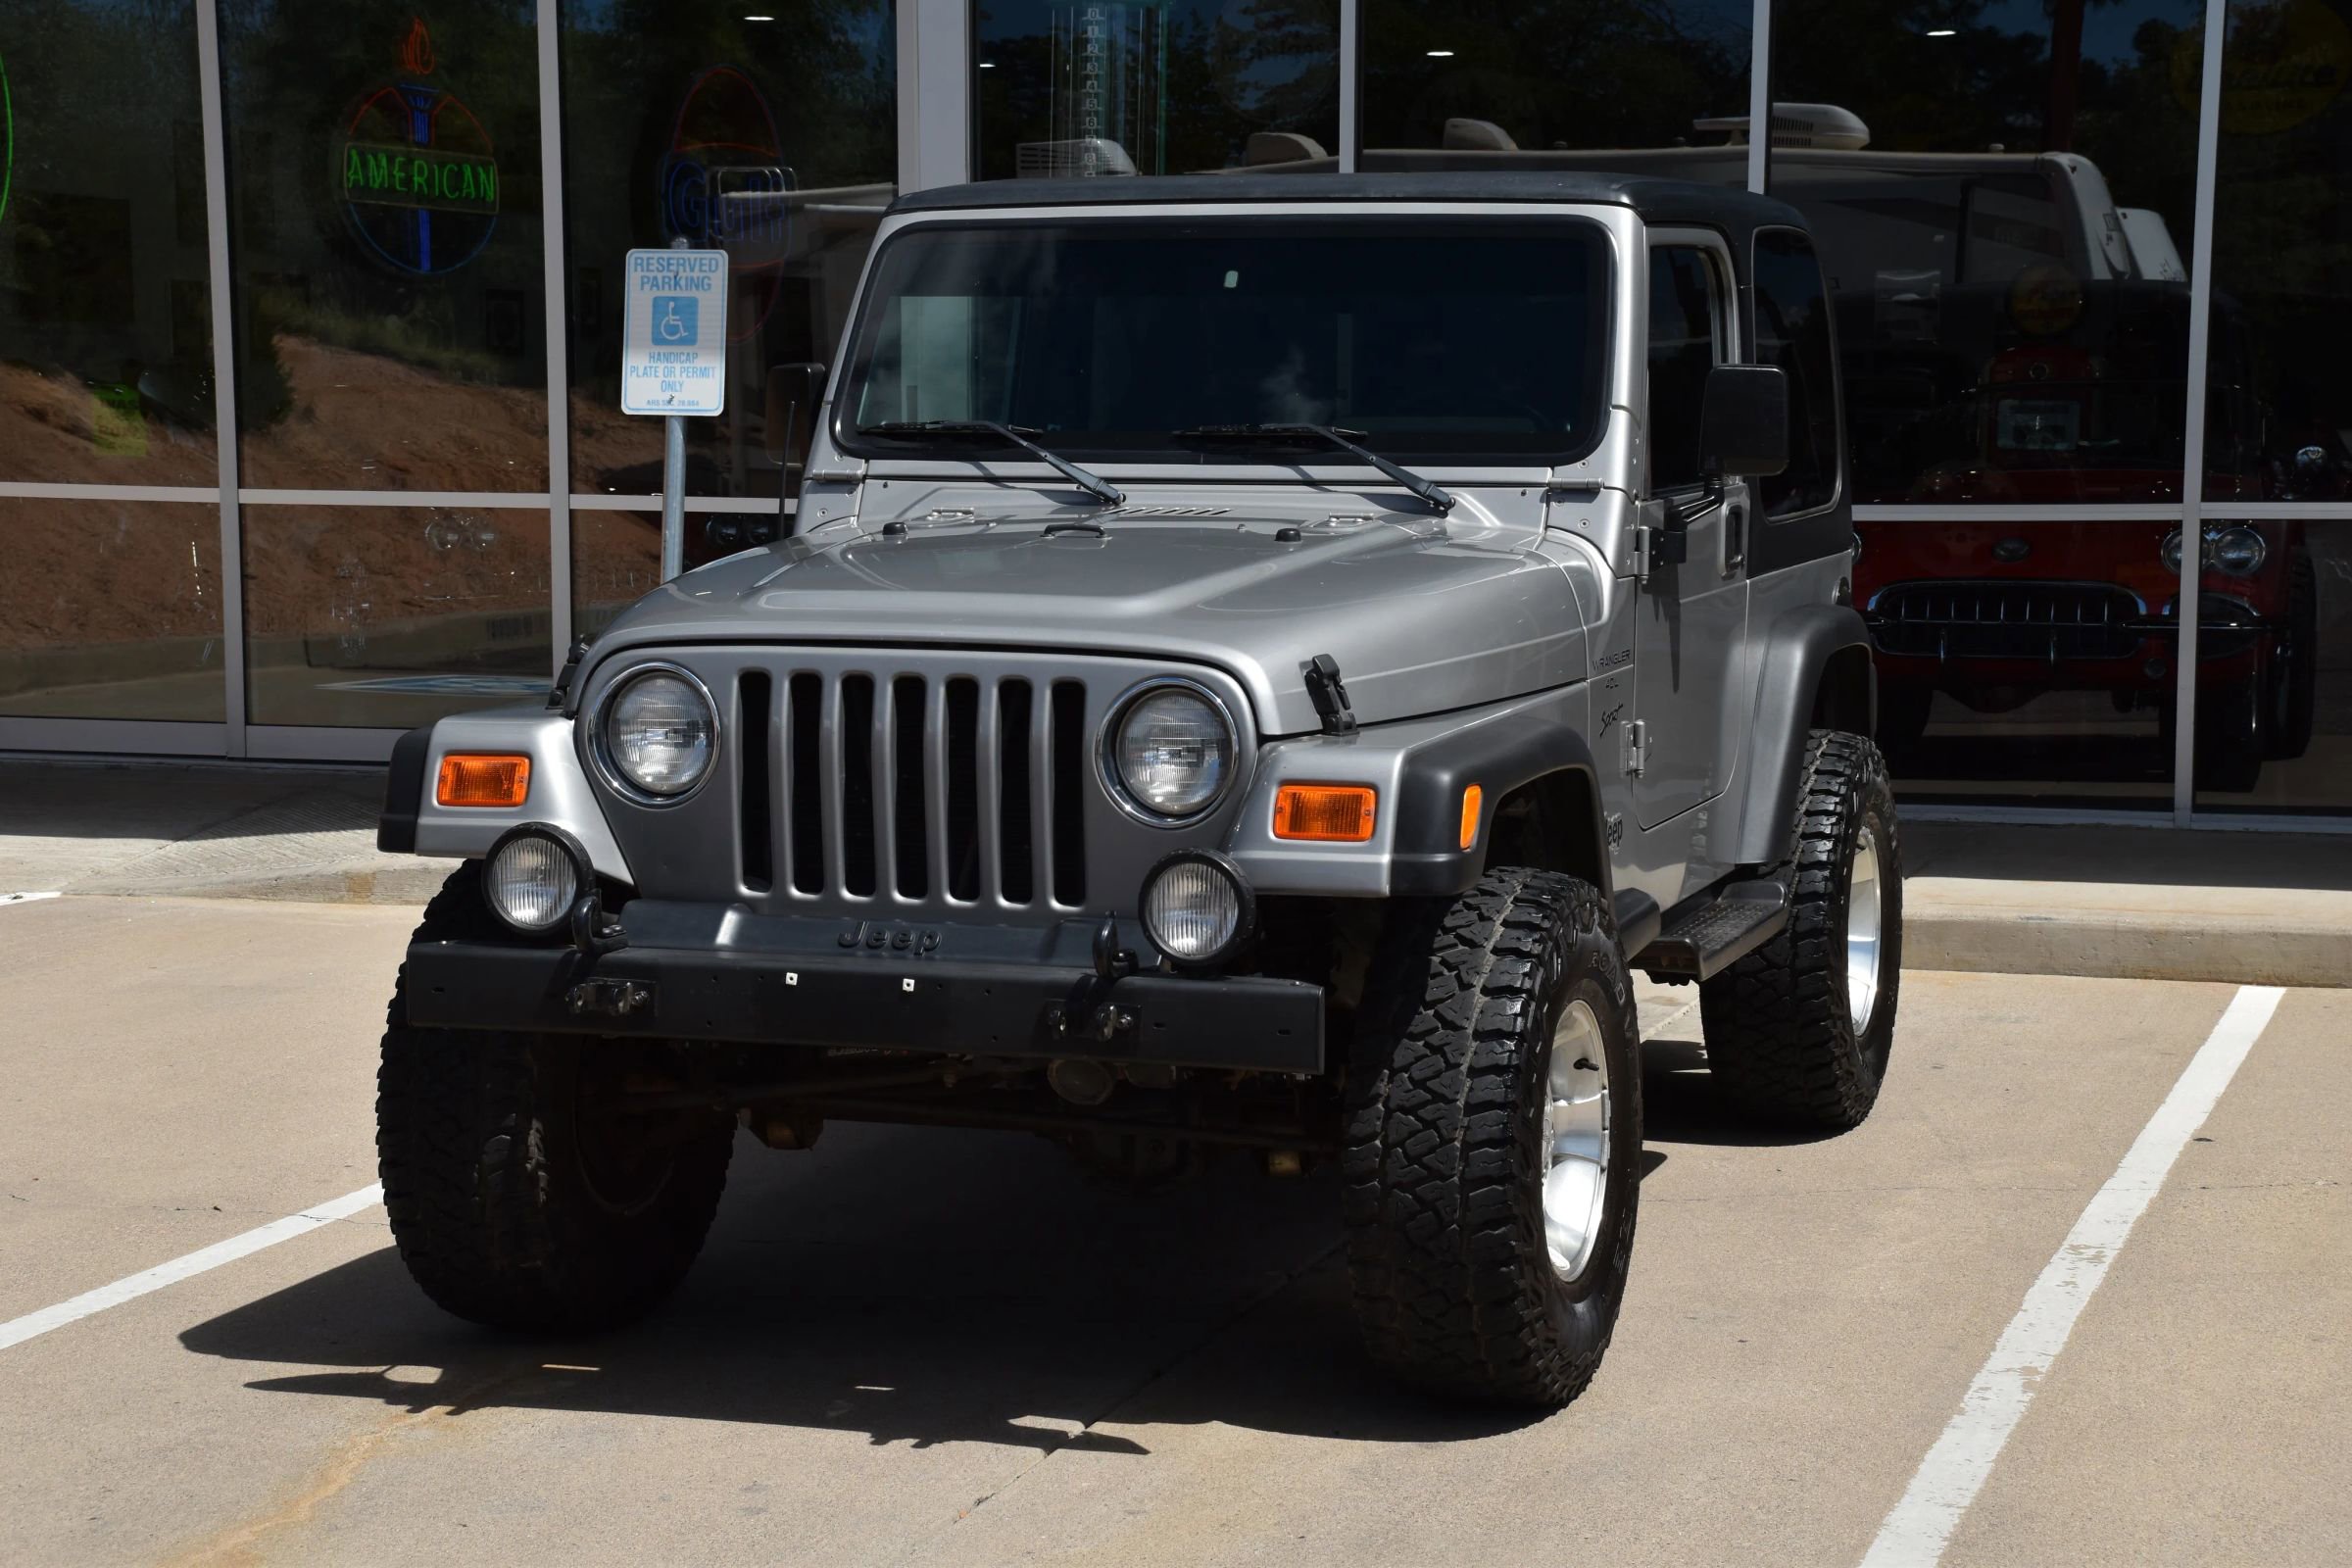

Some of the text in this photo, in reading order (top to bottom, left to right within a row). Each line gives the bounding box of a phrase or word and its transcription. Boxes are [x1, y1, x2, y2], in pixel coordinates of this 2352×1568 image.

[347, 148, 495, 202] AMERICAN
[633, 256, 719, 272] RESERVED
[640, 274, 712, 291] PARKING
[648, 352, 699, 365] HANDICAP
[629, 365, 716, 379] PLATE OR PERMIT
[661, 379, 684, 393] ONLY
[1592, 649, 1631, 671] WRANGLER
[1599, 702, 1624, 738] Sport
[837, 920, 942, 957] Jeep
